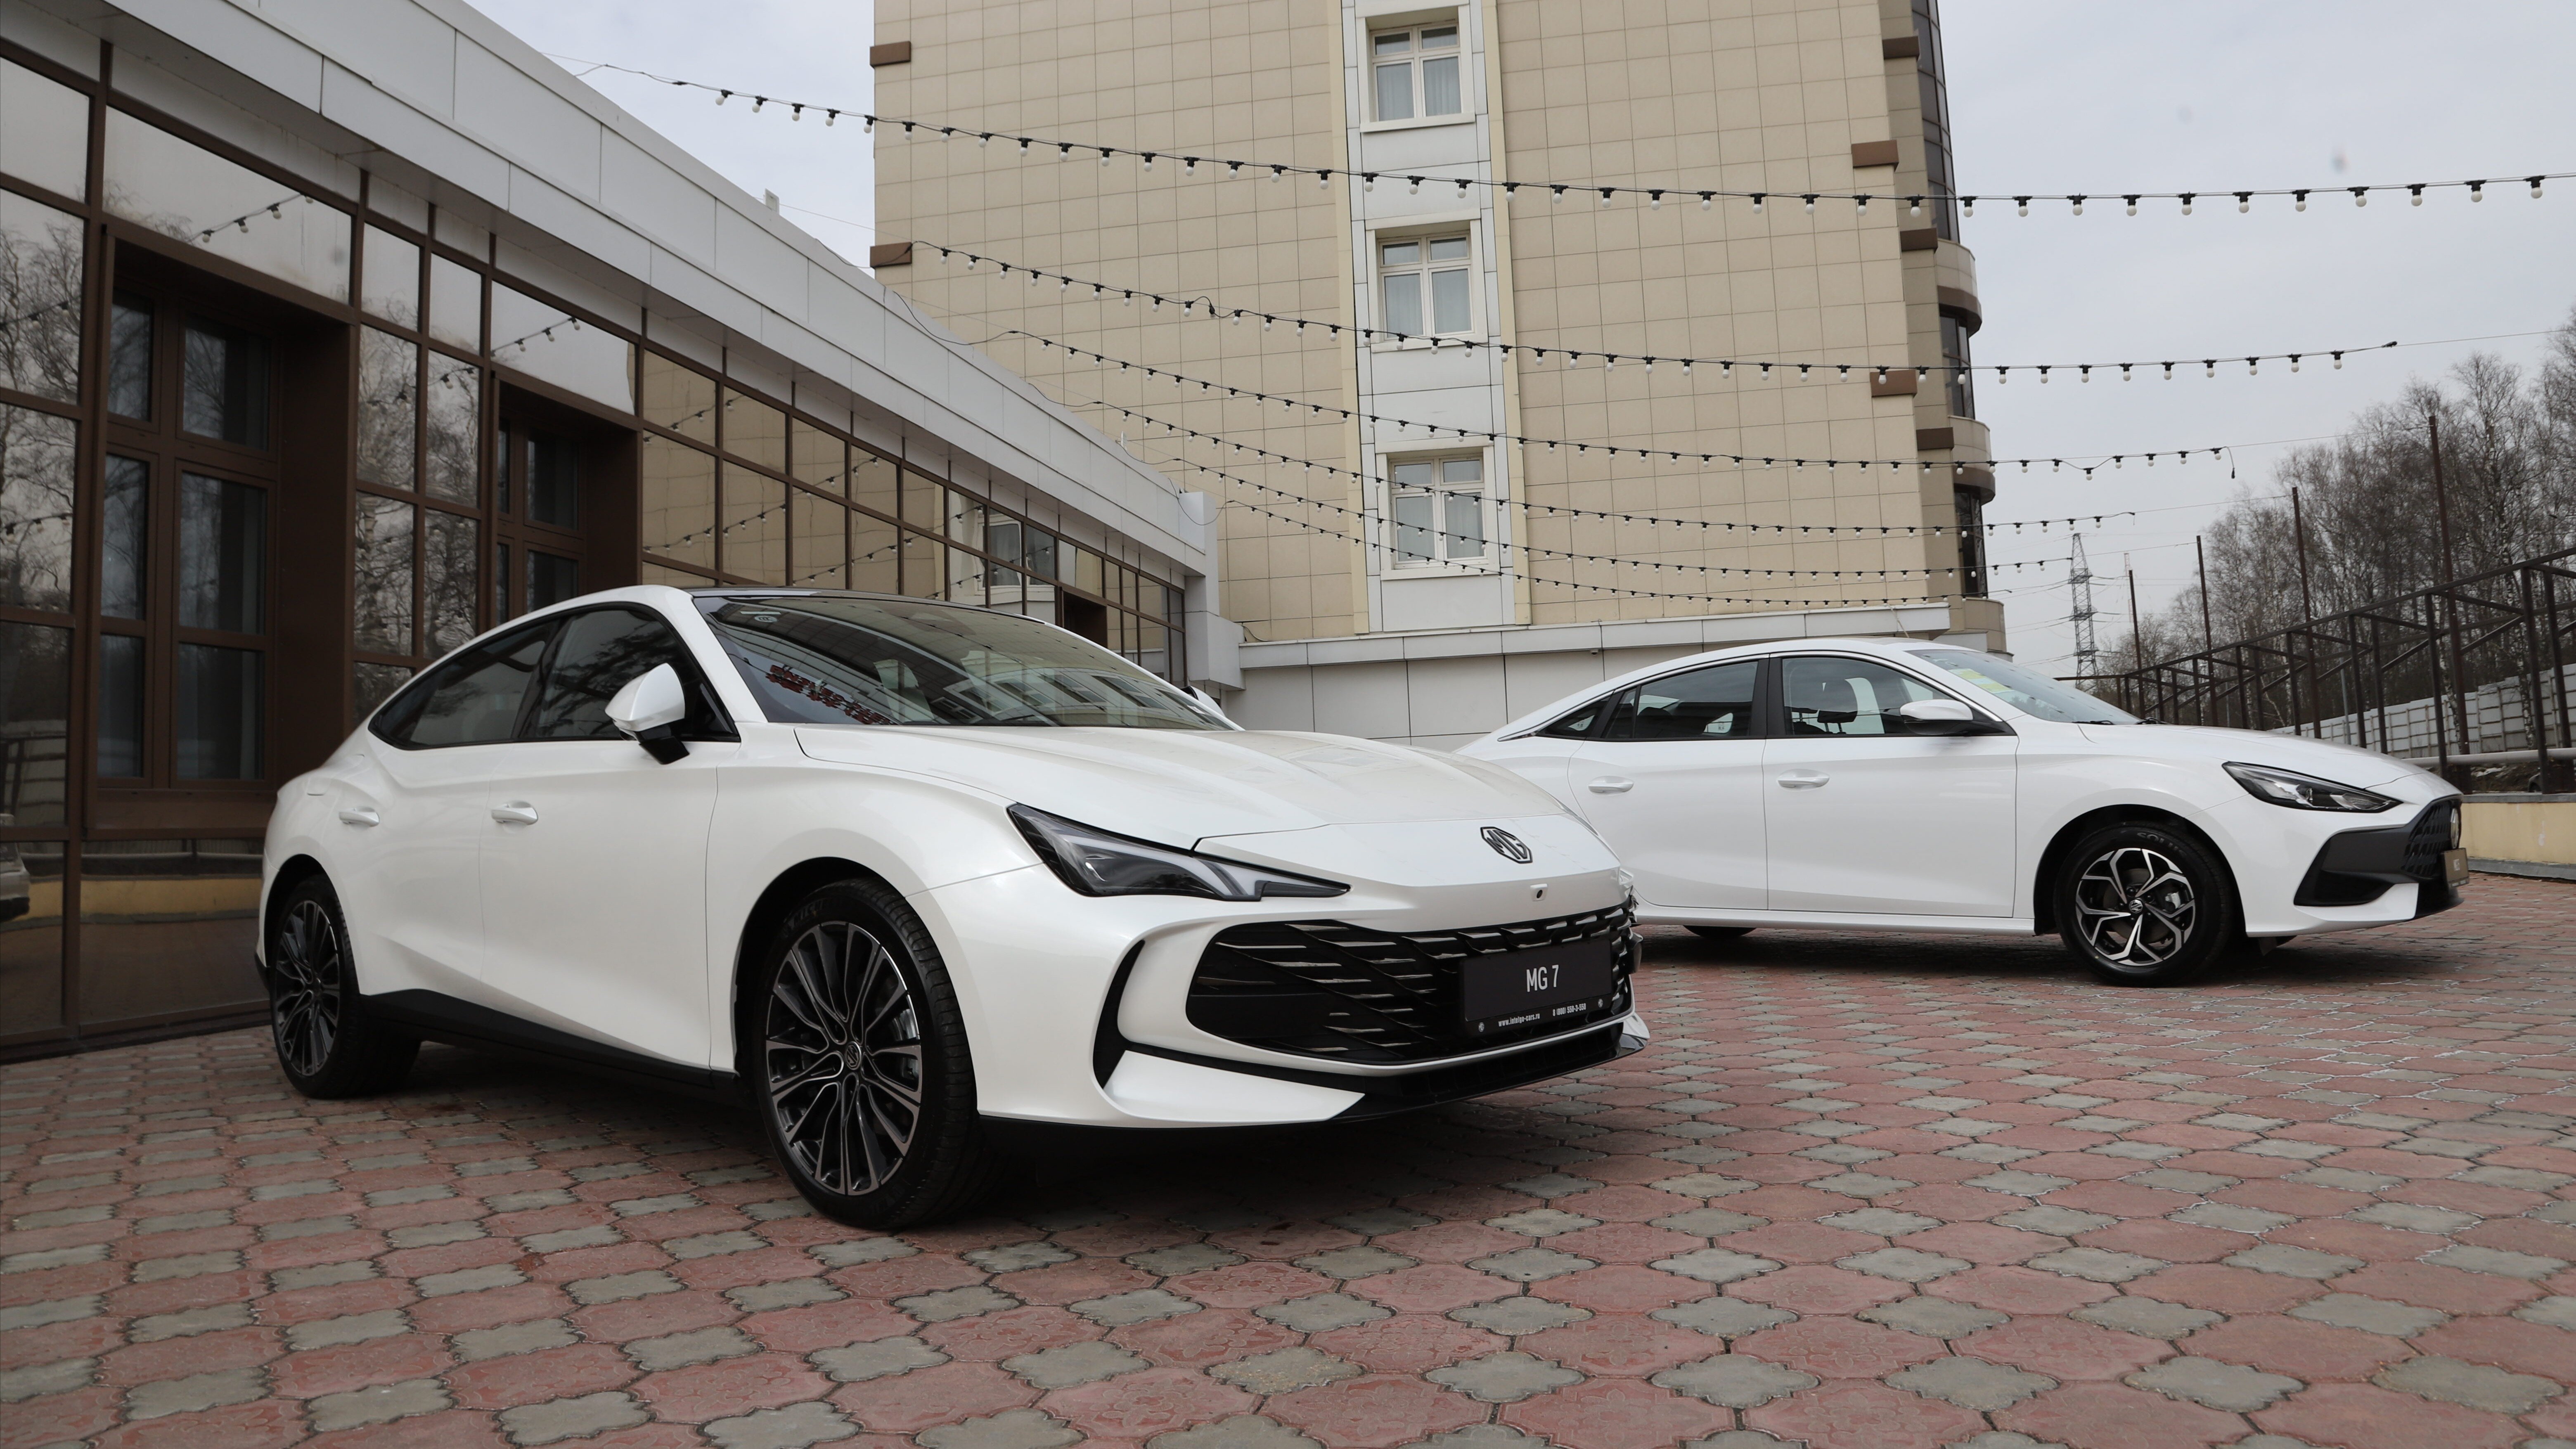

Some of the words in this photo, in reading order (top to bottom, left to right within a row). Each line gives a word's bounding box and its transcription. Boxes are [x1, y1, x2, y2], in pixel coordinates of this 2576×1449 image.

[1486, 829, 1528, 860] MG
[1526, 966, 1548, 992] MG
[1552, 964, 1559, 987] 7
[1567, 1003, 1586, 1013] 550-3-550
